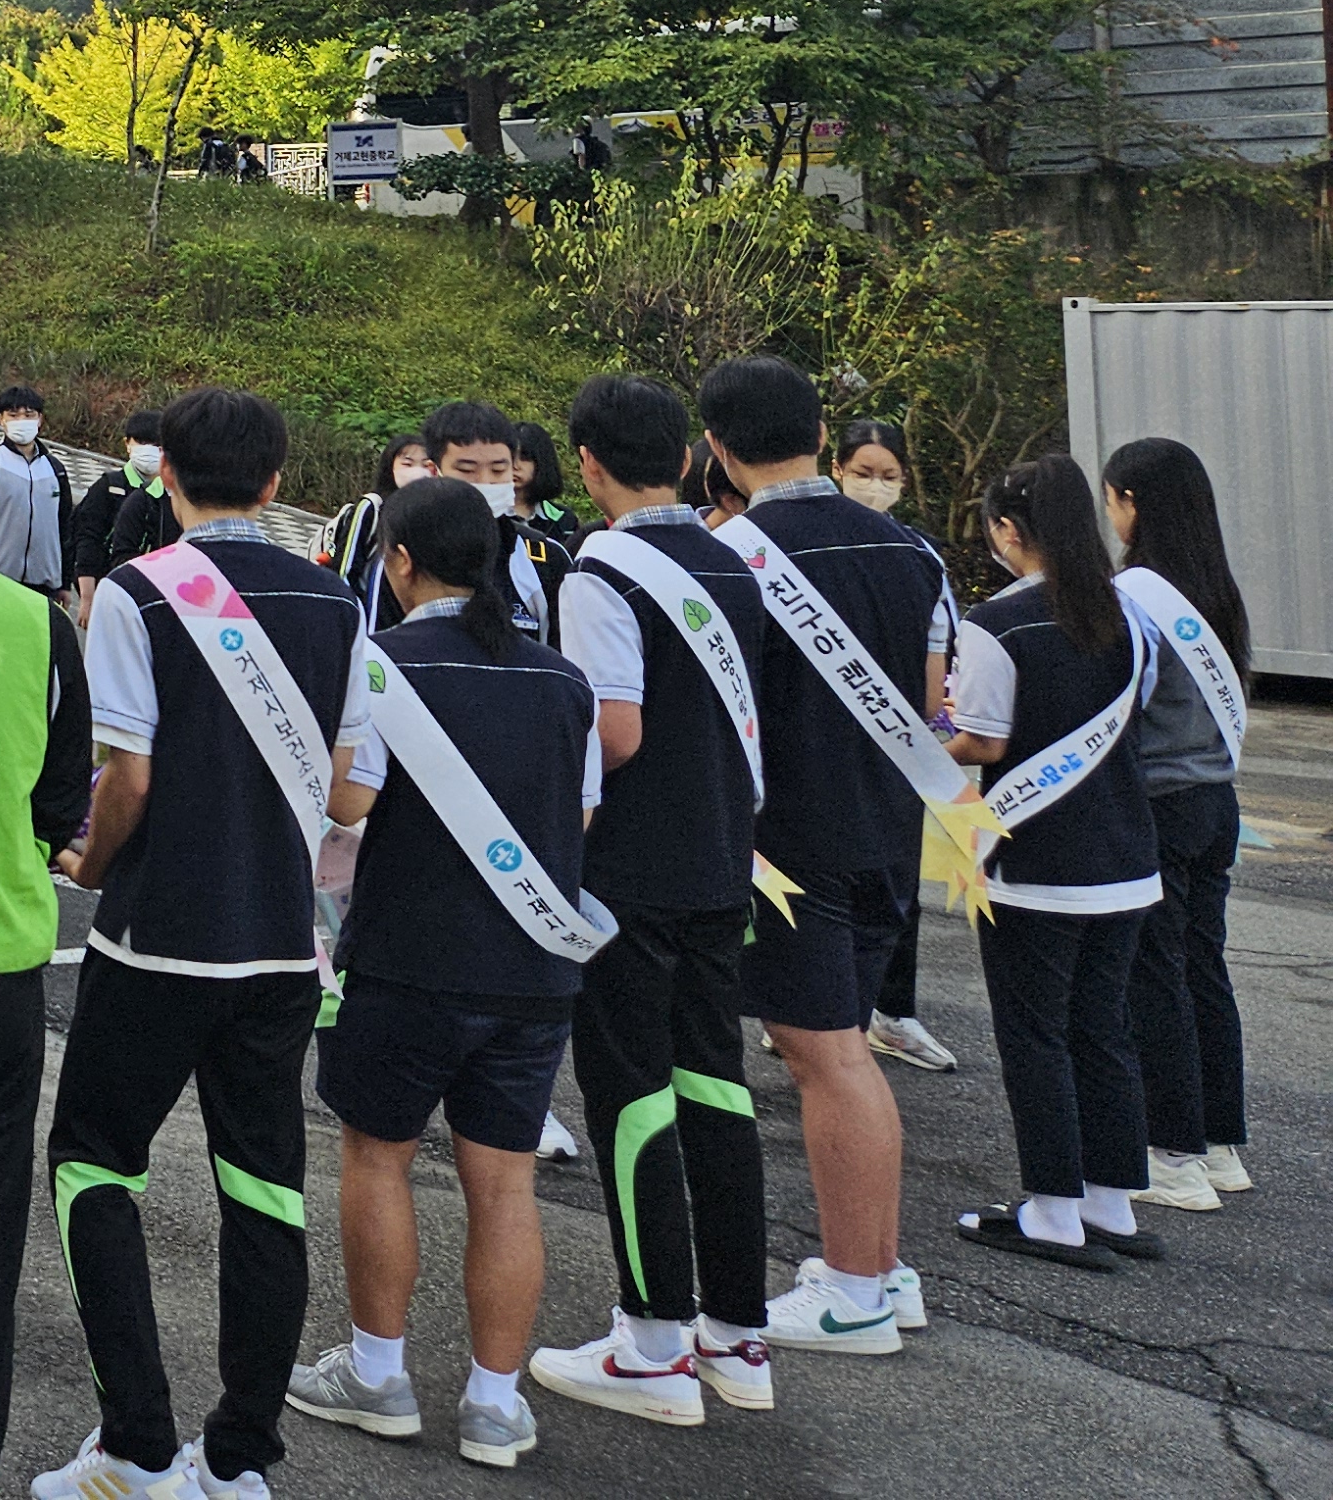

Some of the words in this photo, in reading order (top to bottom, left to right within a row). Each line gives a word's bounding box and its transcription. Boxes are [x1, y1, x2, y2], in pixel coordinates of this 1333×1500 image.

[334, 150, 397, 162] 거제고현중학교
[766, 573, 846, 655] 친구야
[836, 658, 914, 747] 괜찮니?
[1193, 643, 1224, 683] 거제시
[235, 650, 286, 716] 거제시
[274, 718, 315, 778] 보건소
[1037, 752, 1083, 787] 생명
[513, 877, 567, 930] 거제시
